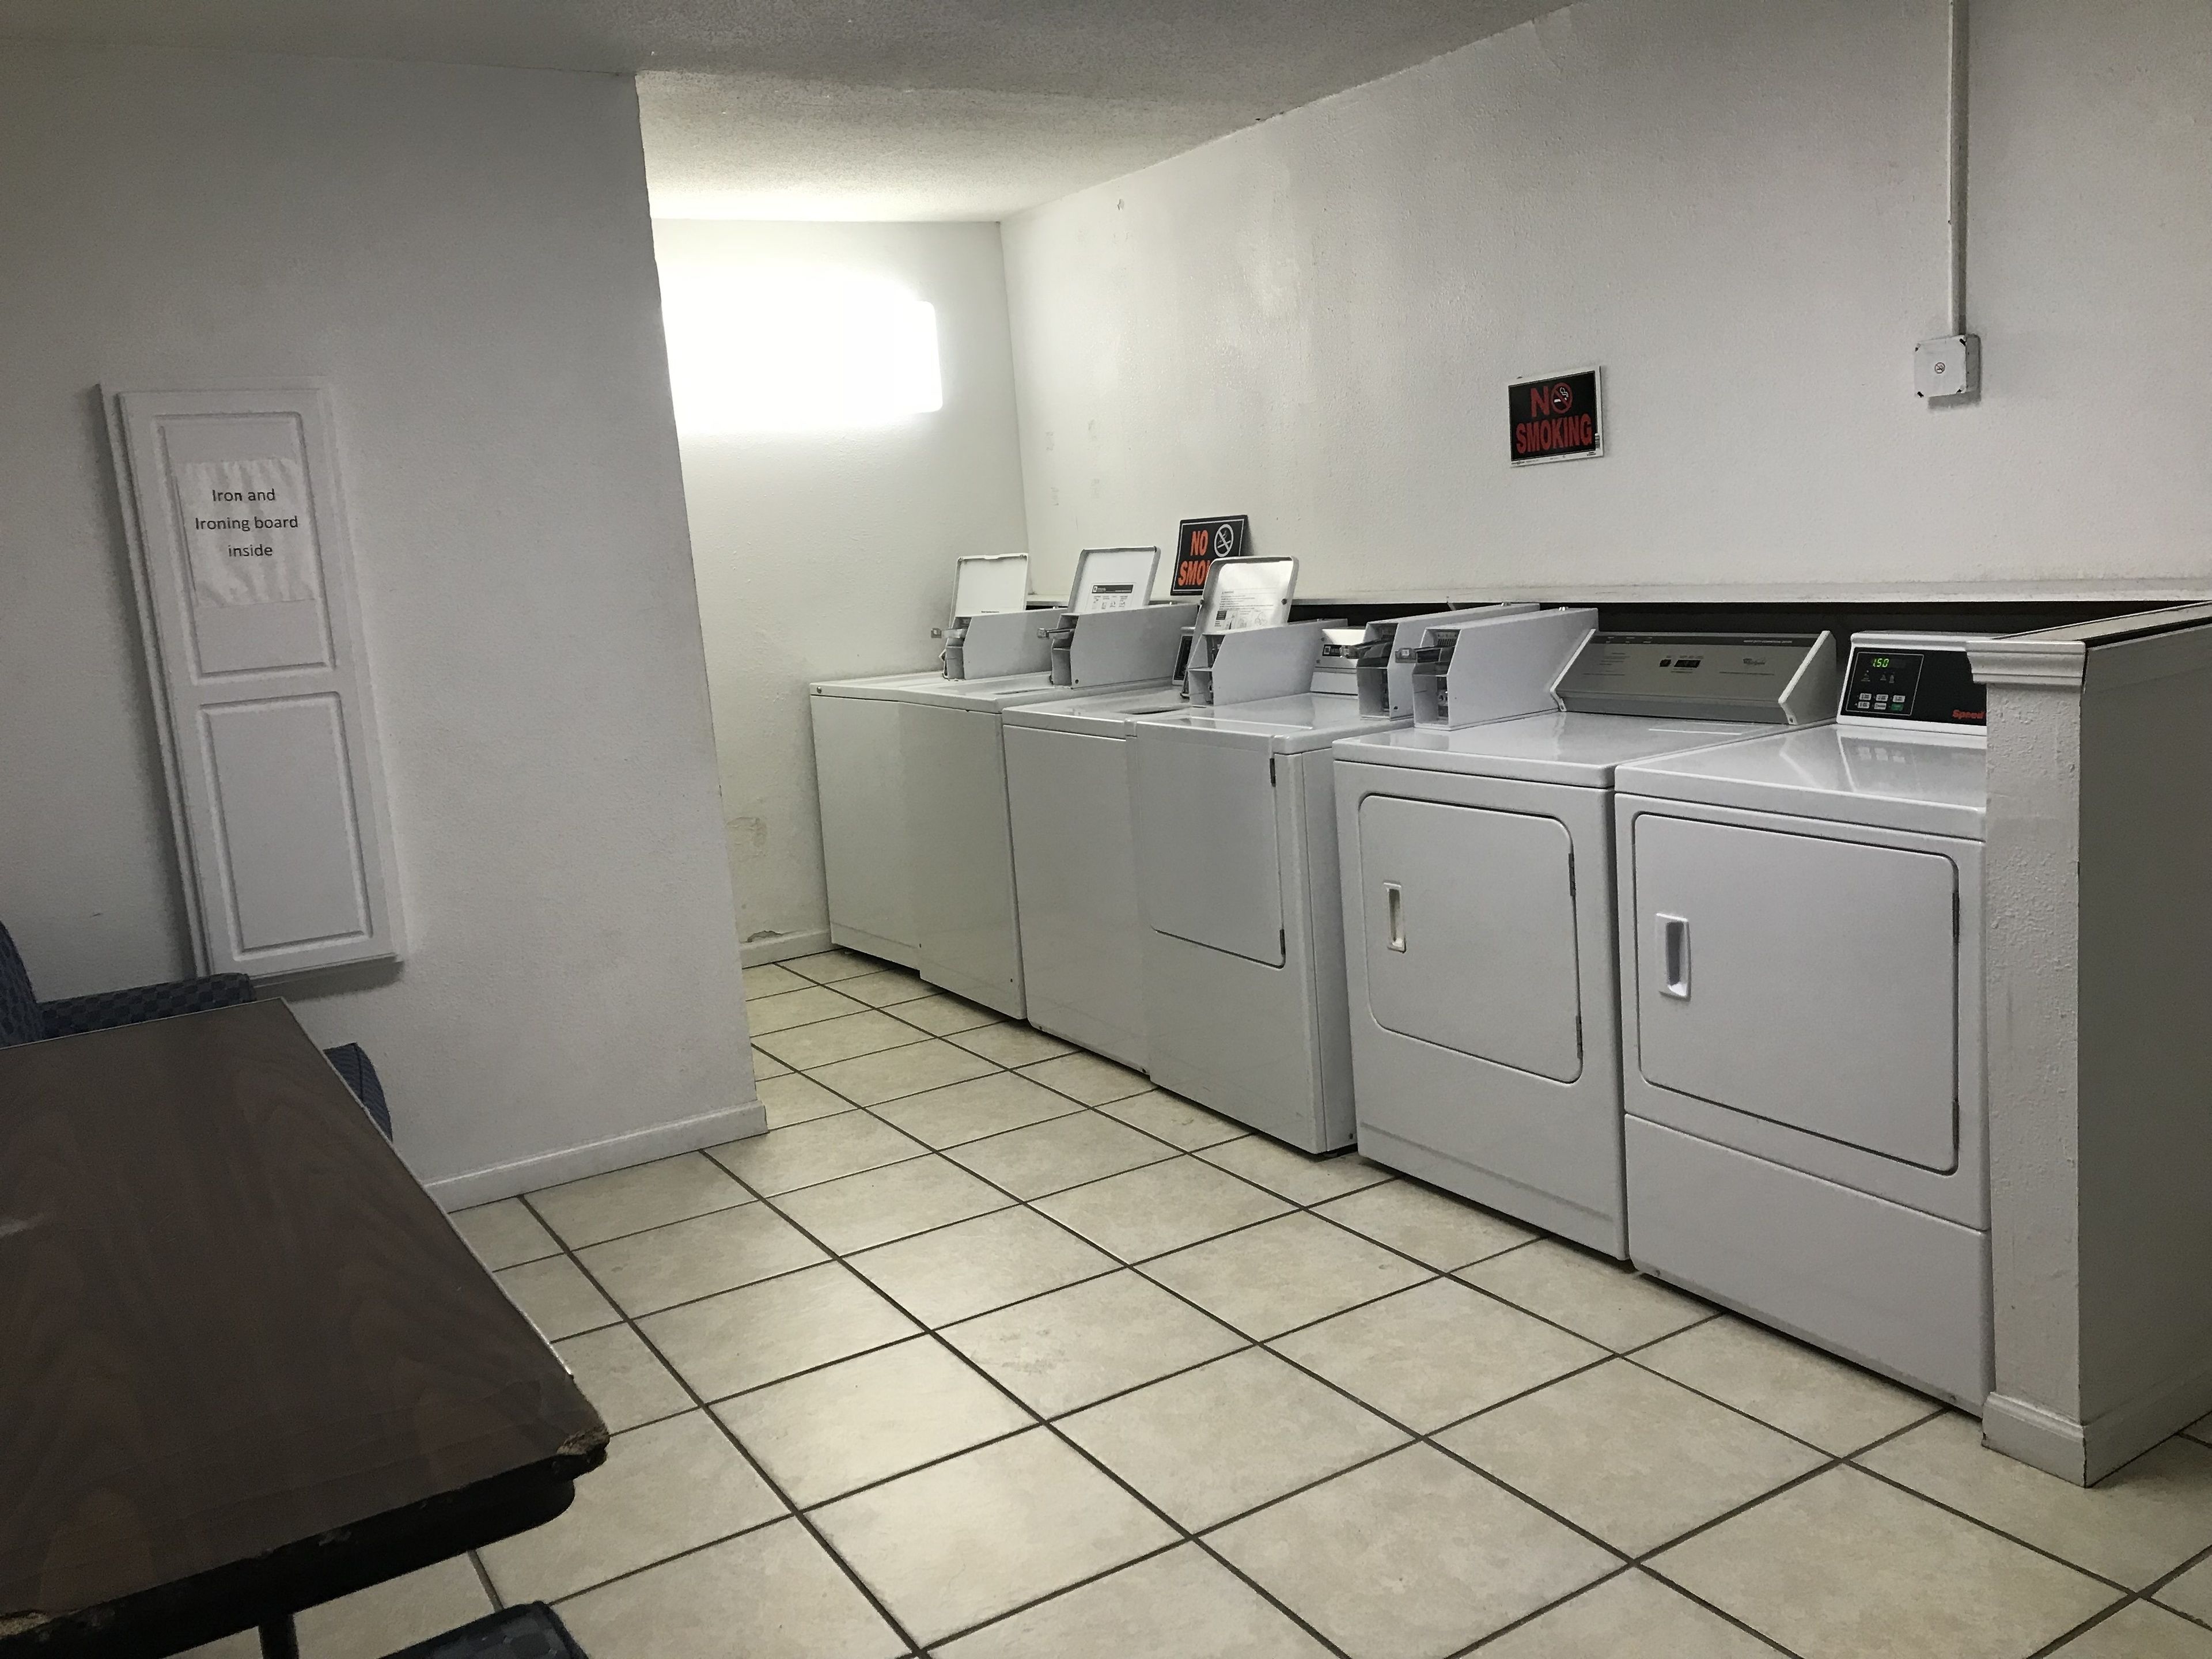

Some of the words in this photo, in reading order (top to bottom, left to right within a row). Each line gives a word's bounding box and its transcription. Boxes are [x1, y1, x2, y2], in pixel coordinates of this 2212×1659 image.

[1516, 414, 1592, 453] SMOKING
[212, 490, 243, 502] Iron
[248, 488, 275, 501] and
[195, 517, 250, 532] Ironing
[254, 516, 298, 529] board
[228, 544, 272, 557] inside
[1190, 530, 1209, 556] NO
